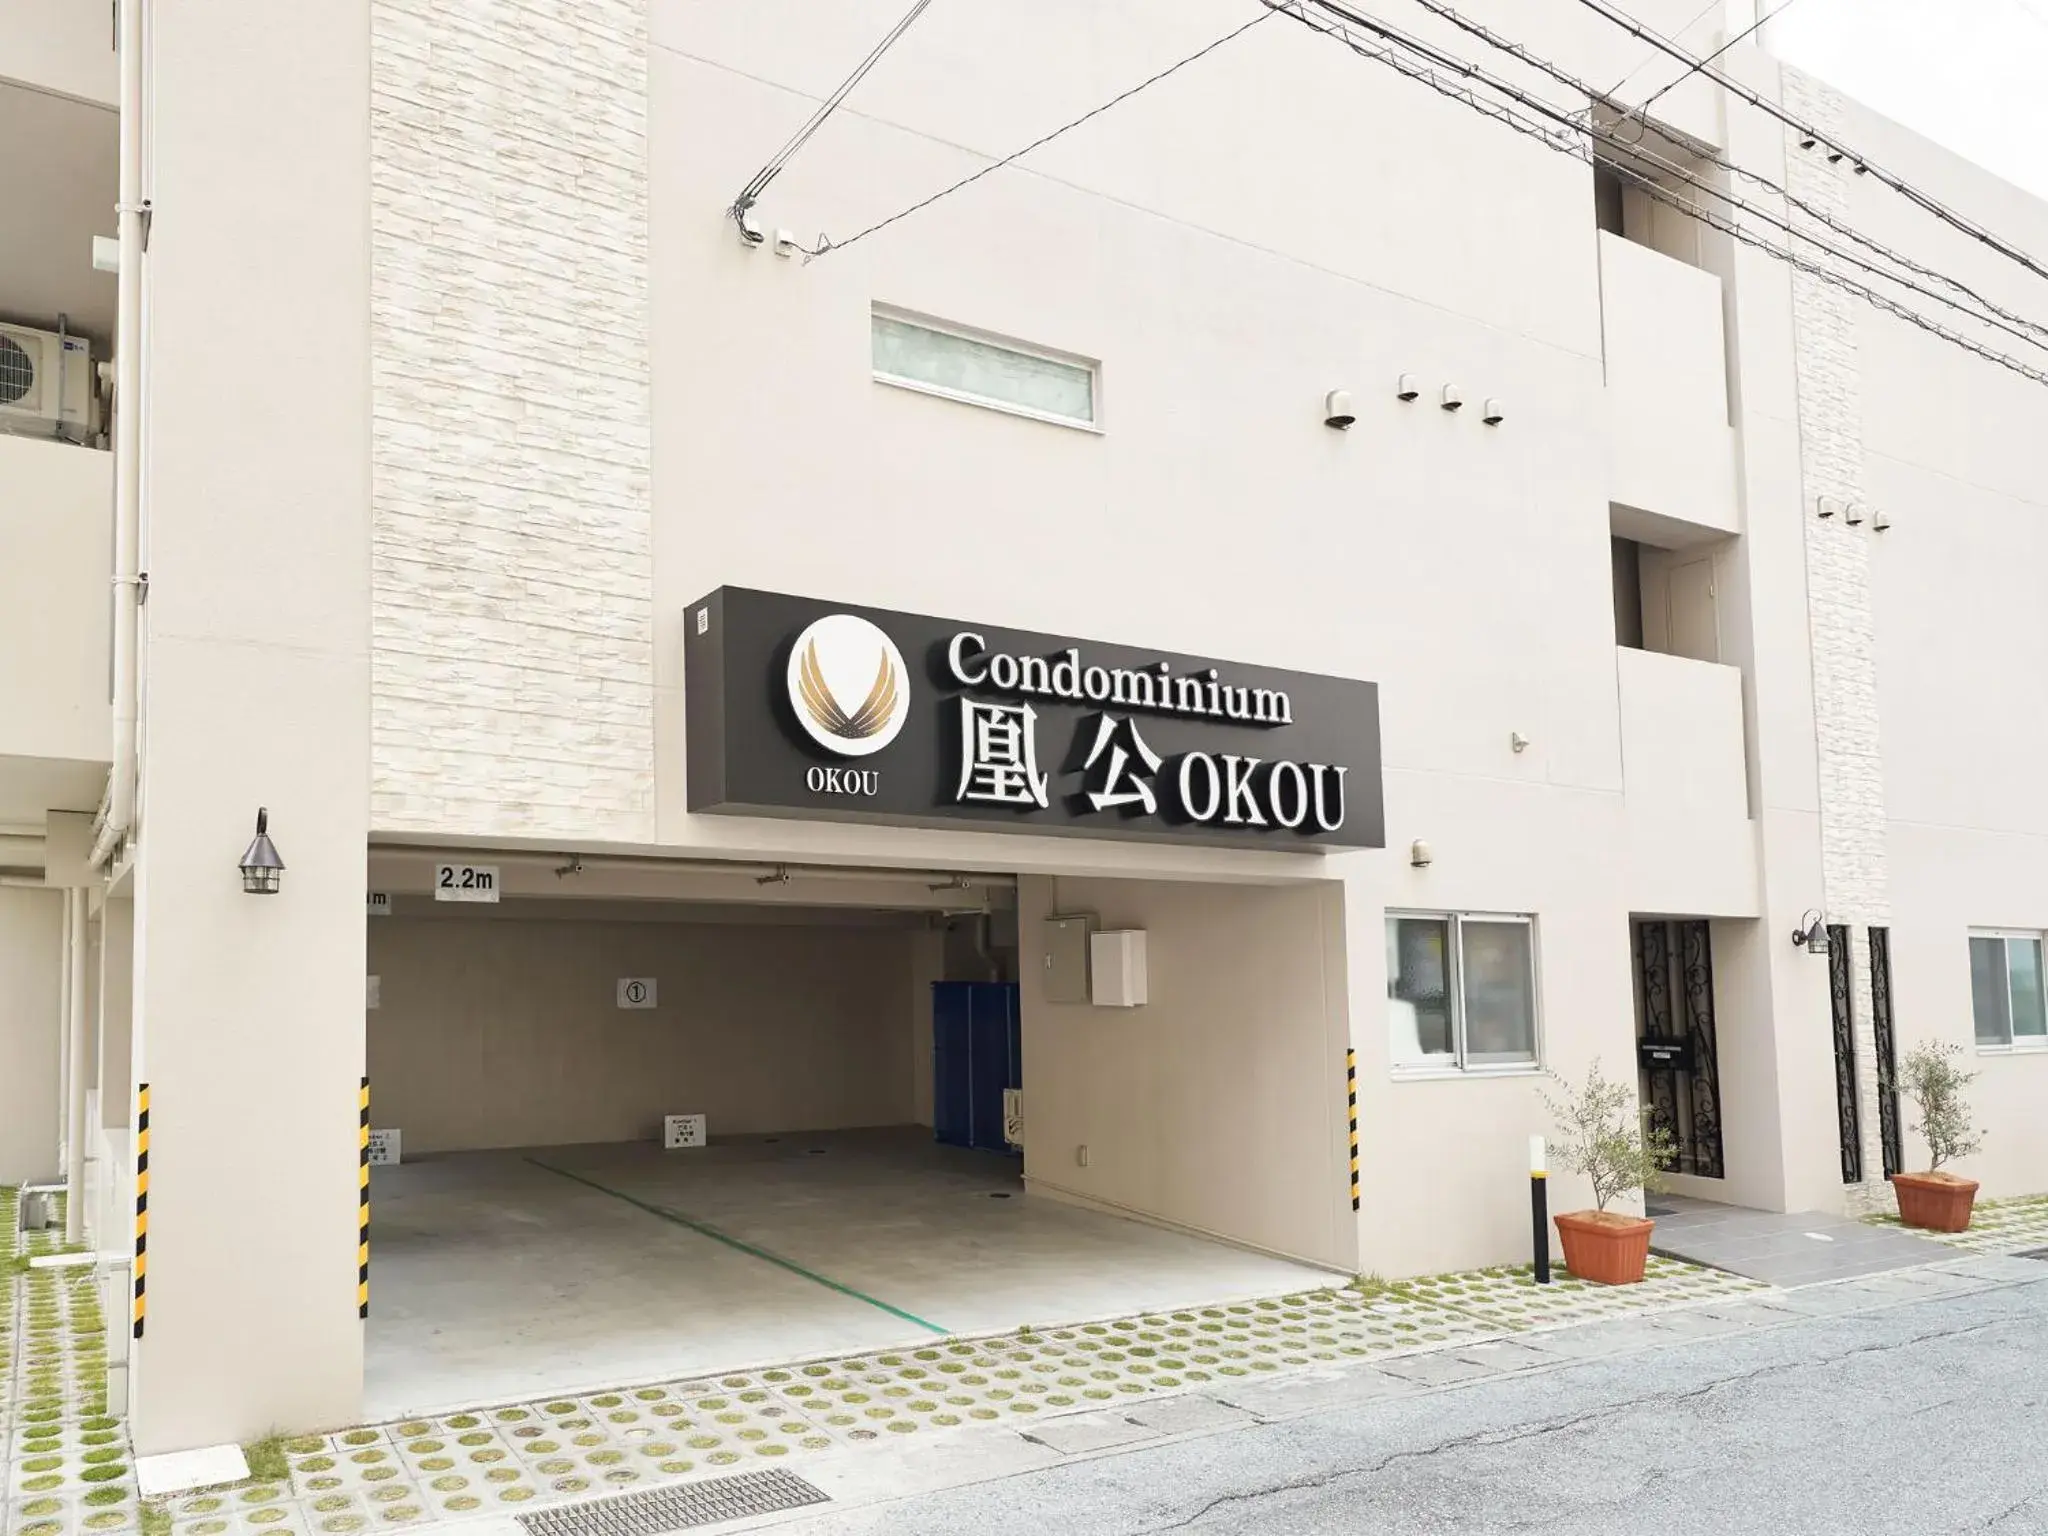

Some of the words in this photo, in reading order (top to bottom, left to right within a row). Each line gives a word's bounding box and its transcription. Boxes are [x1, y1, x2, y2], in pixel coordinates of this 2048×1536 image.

[948, 631, 1294, 724] Condominium
[806, 766, 880, 796] OKOU
[1179, 751, 1349, 831] OKOU
[440, 866, 493, 890] 2.2m
